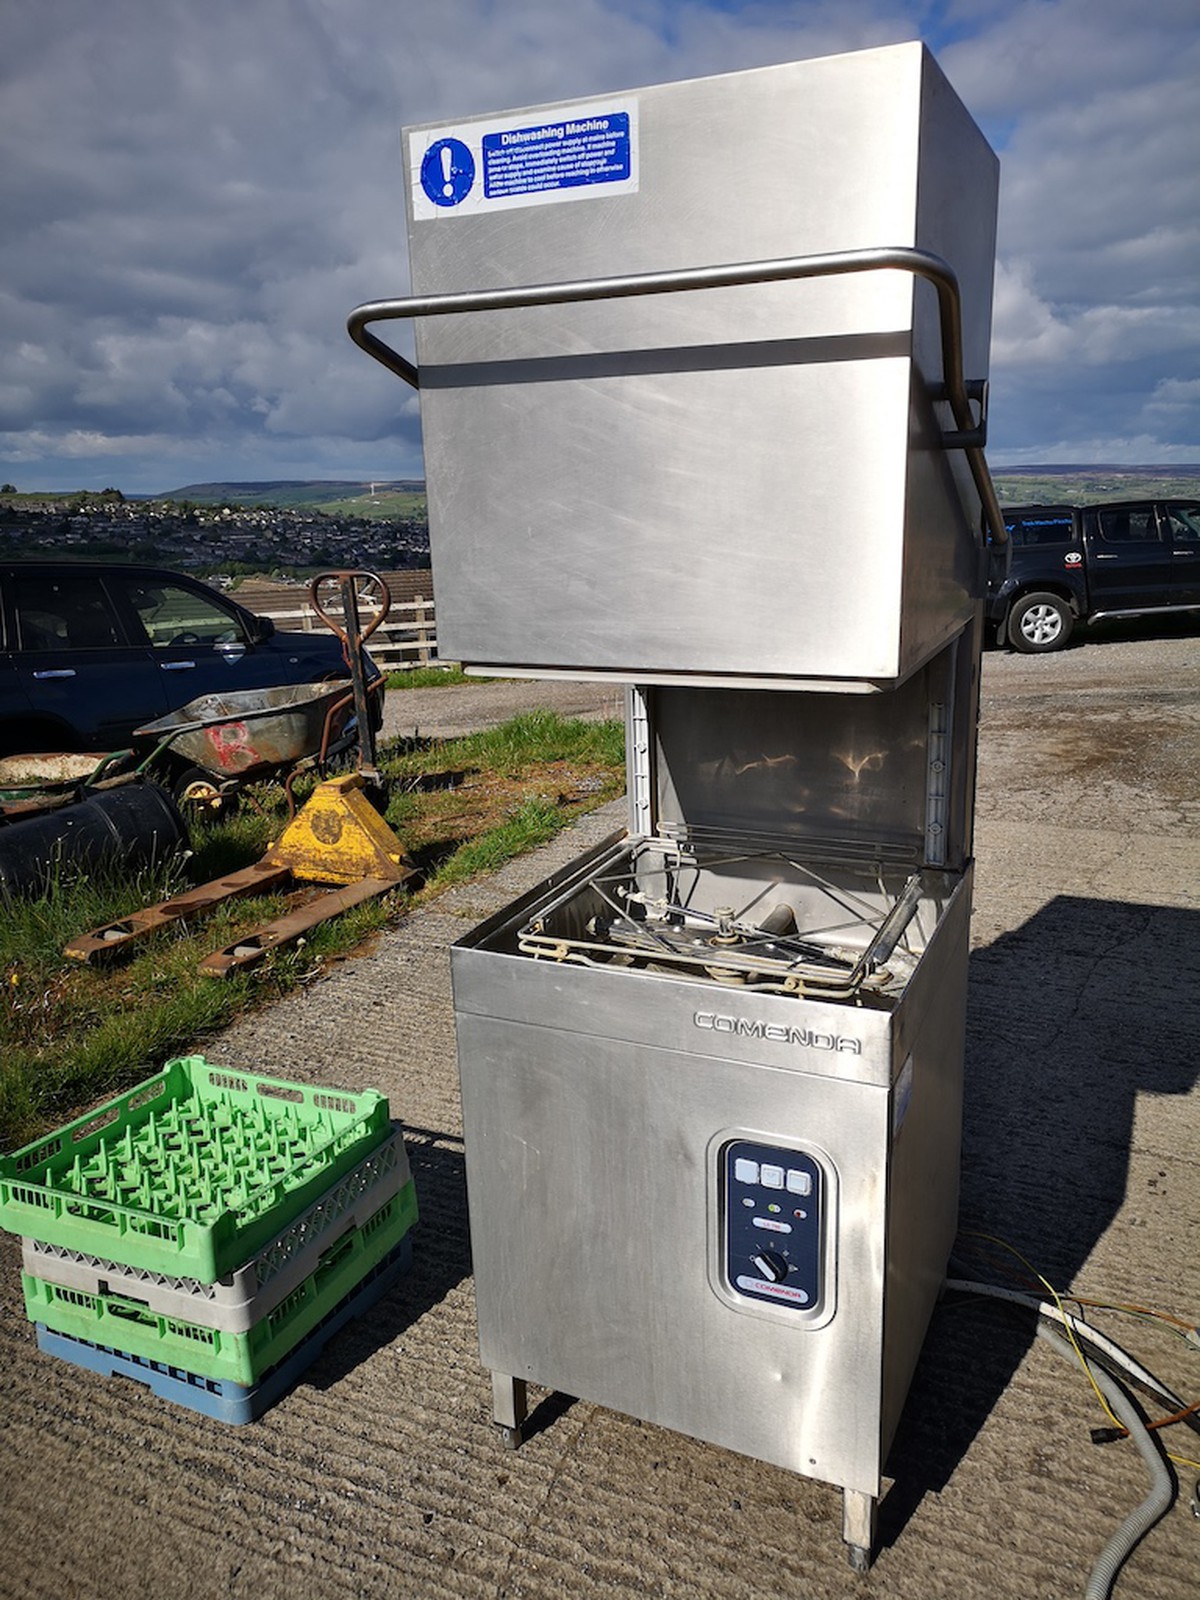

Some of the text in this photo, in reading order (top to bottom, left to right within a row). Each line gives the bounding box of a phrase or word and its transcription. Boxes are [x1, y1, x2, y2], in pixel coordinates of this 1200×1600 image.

[501, 119, 609, 146] Dishwashing Machine
[605, 130, 624, 139] before
[693, 1011, 862, 1055] COMENDA
